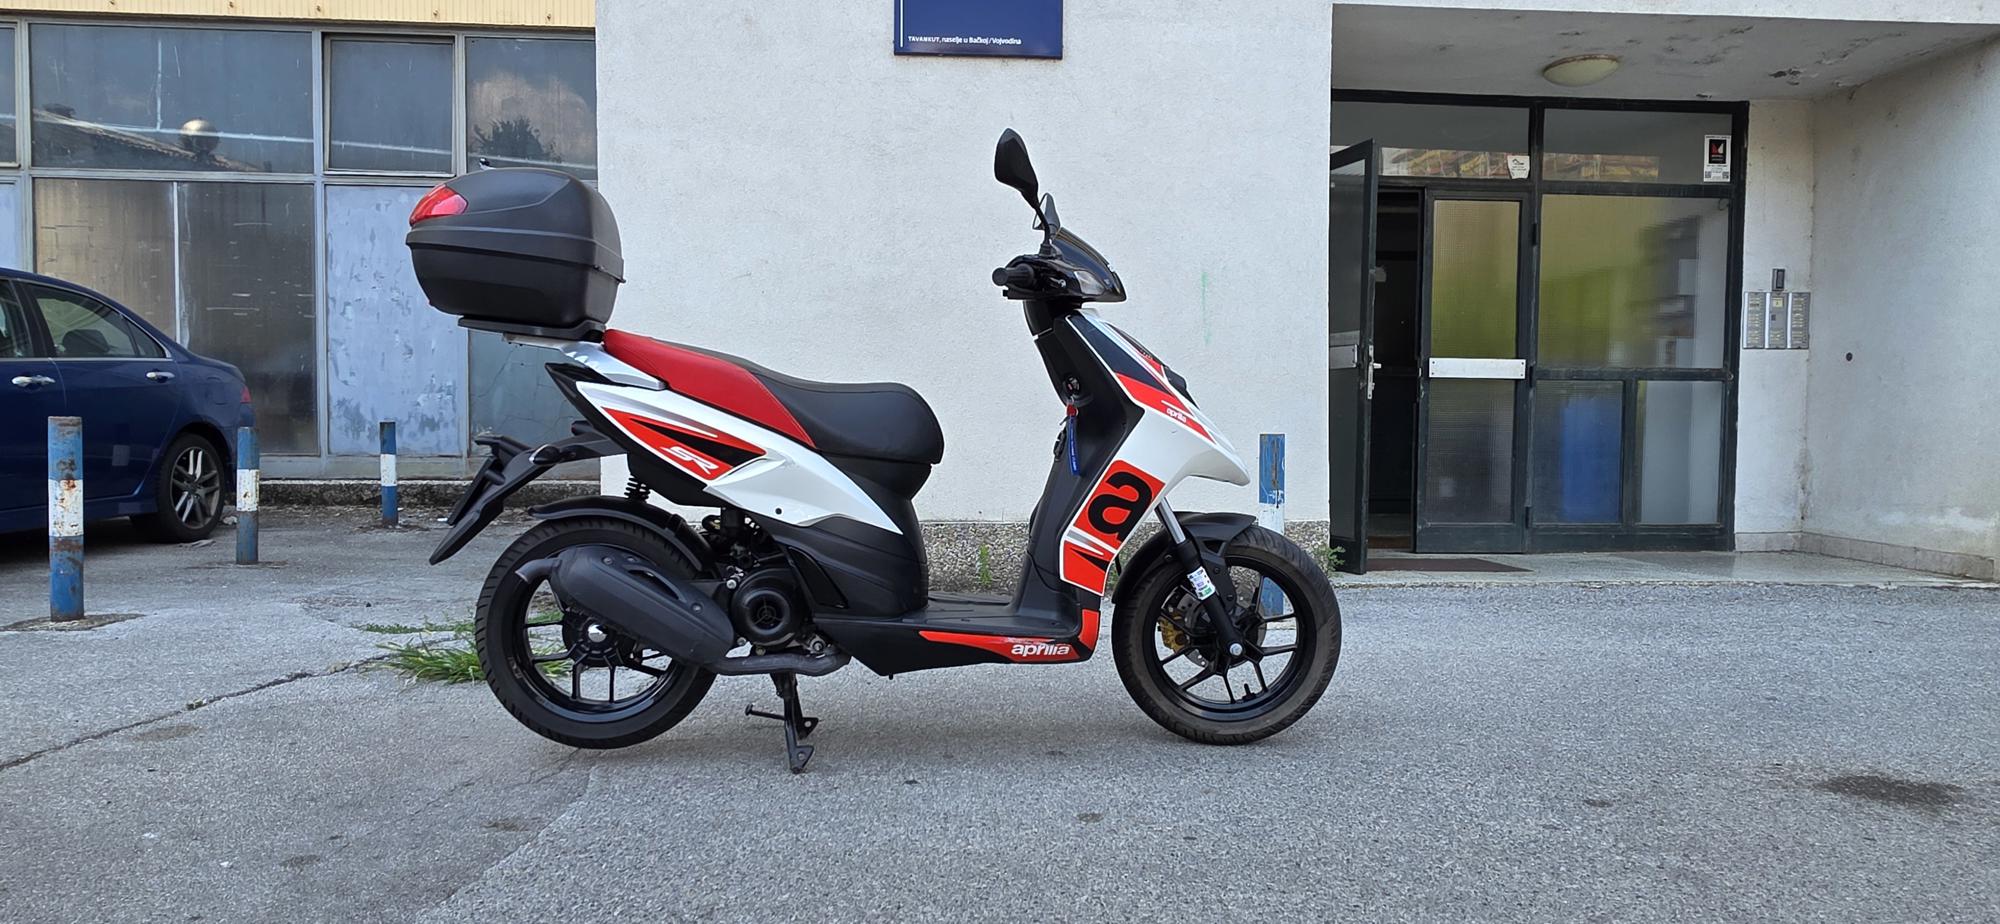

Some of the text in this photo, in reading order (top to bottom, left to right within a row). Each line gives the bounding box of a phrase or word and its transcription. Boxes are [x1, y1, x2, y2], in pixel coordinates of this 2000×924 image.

[1166, 407, 1187, 423] aprilia
[661, 446, 719, 475] SR
[1011, 643, 1069, 657] aprilia
